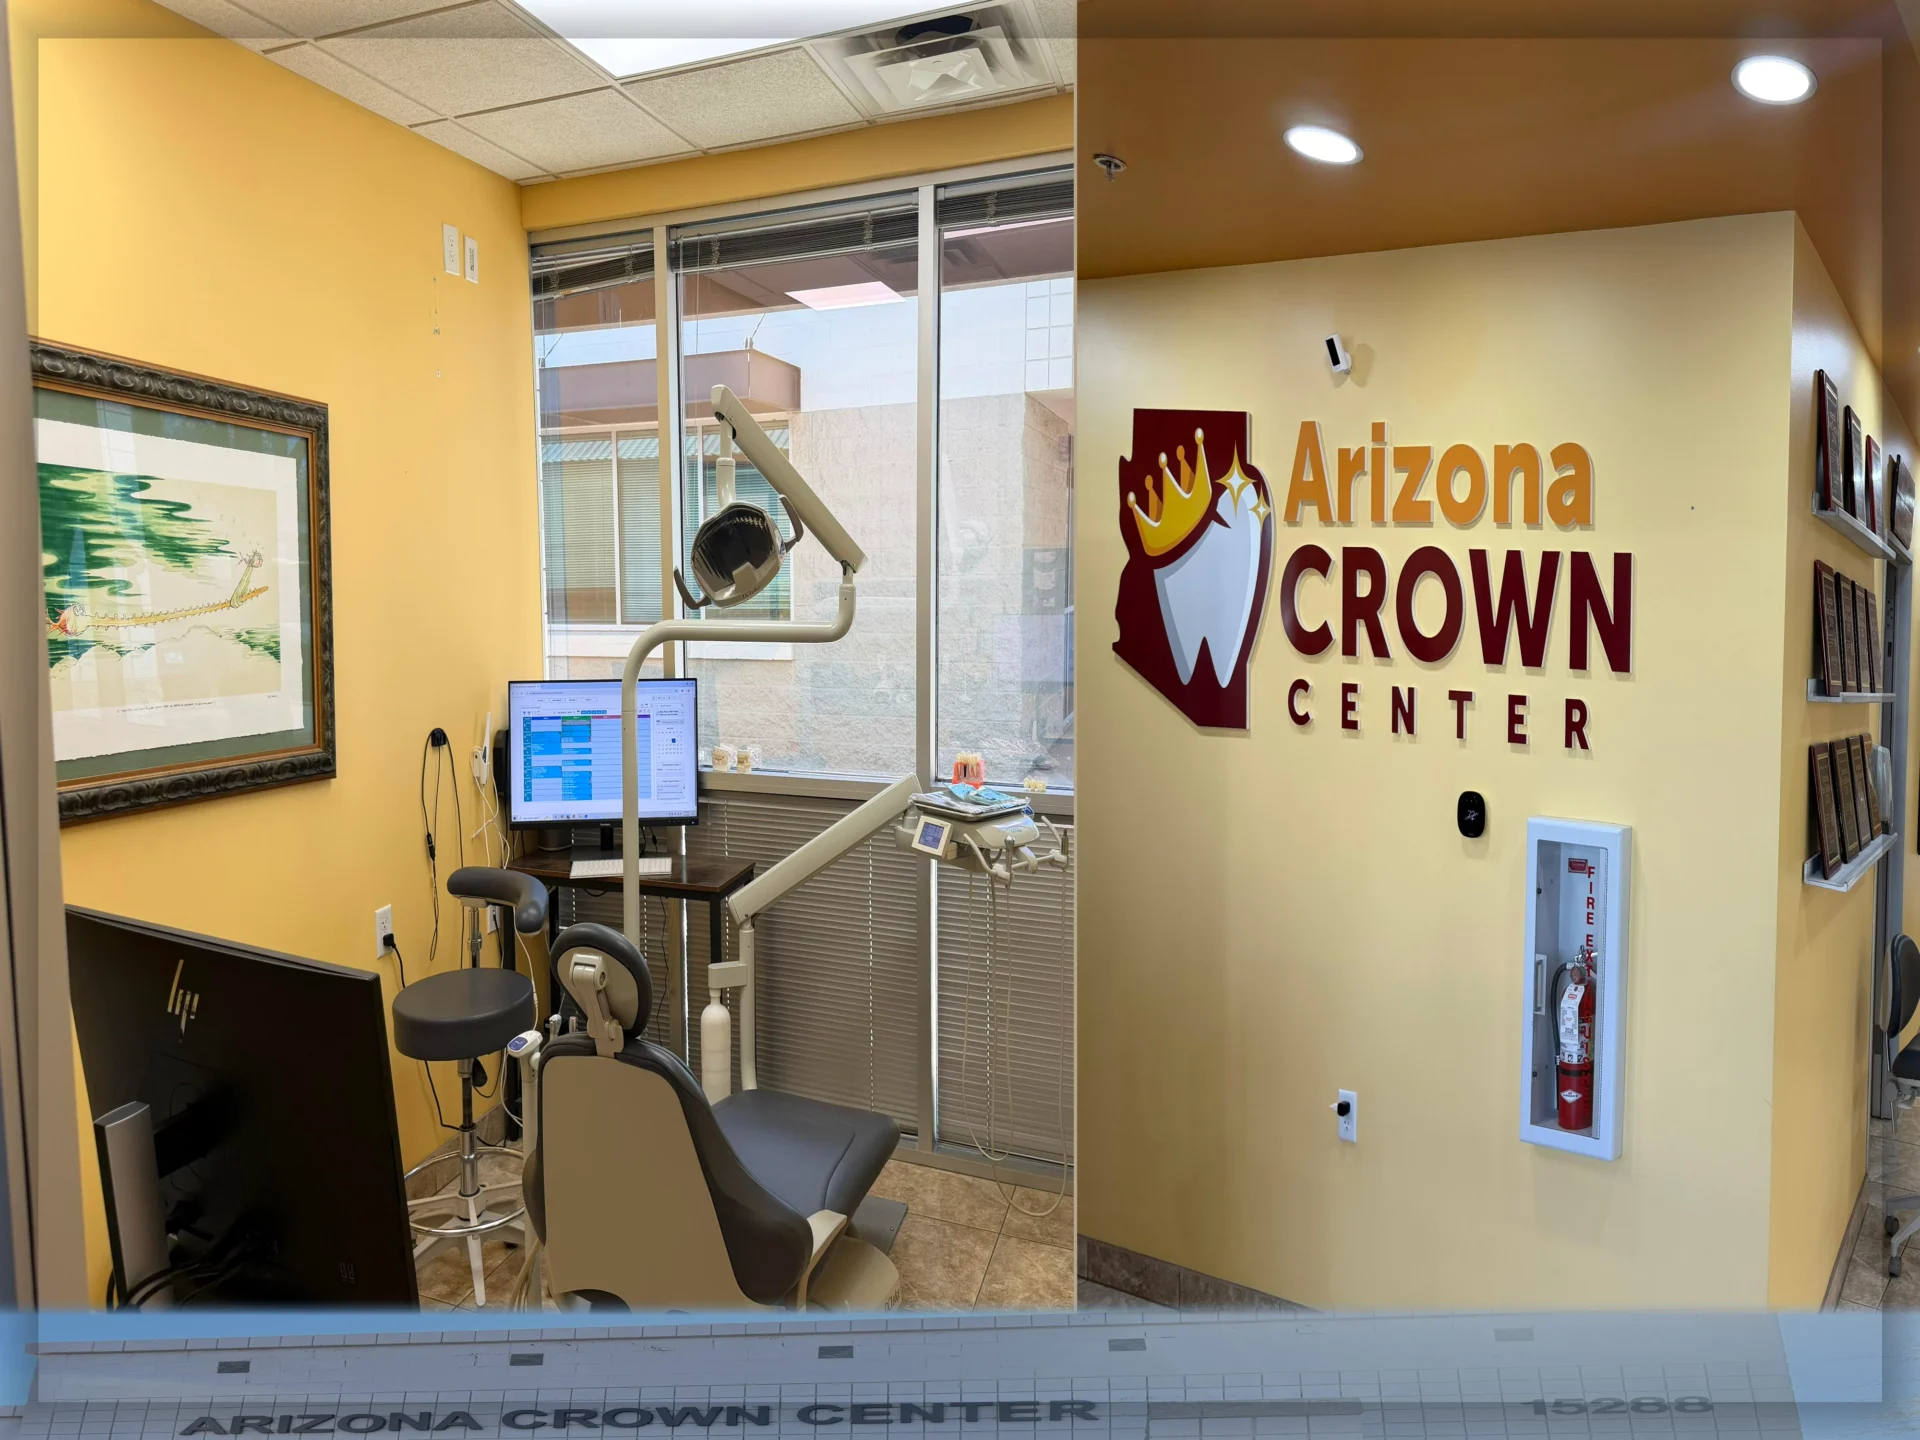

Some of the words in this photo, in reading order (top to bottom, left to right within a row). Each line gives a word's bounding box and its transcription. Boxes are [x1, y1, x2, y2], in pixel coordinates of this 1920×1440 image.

[1283, 420, 1594, 526] Arizona
[1280, 544, 1635, 674] CROWN
[1287, 678, 1592, 750] CENTER
[1586, 866, 1596, 925] FIRE
[178, 1411, 484, 1436] ARIZONA
[501, 1405, 771, 1430] CROWN
[797, 1400, 1100, 1426] CENTER
[1520, 1396, 1715, 1416] 15288
